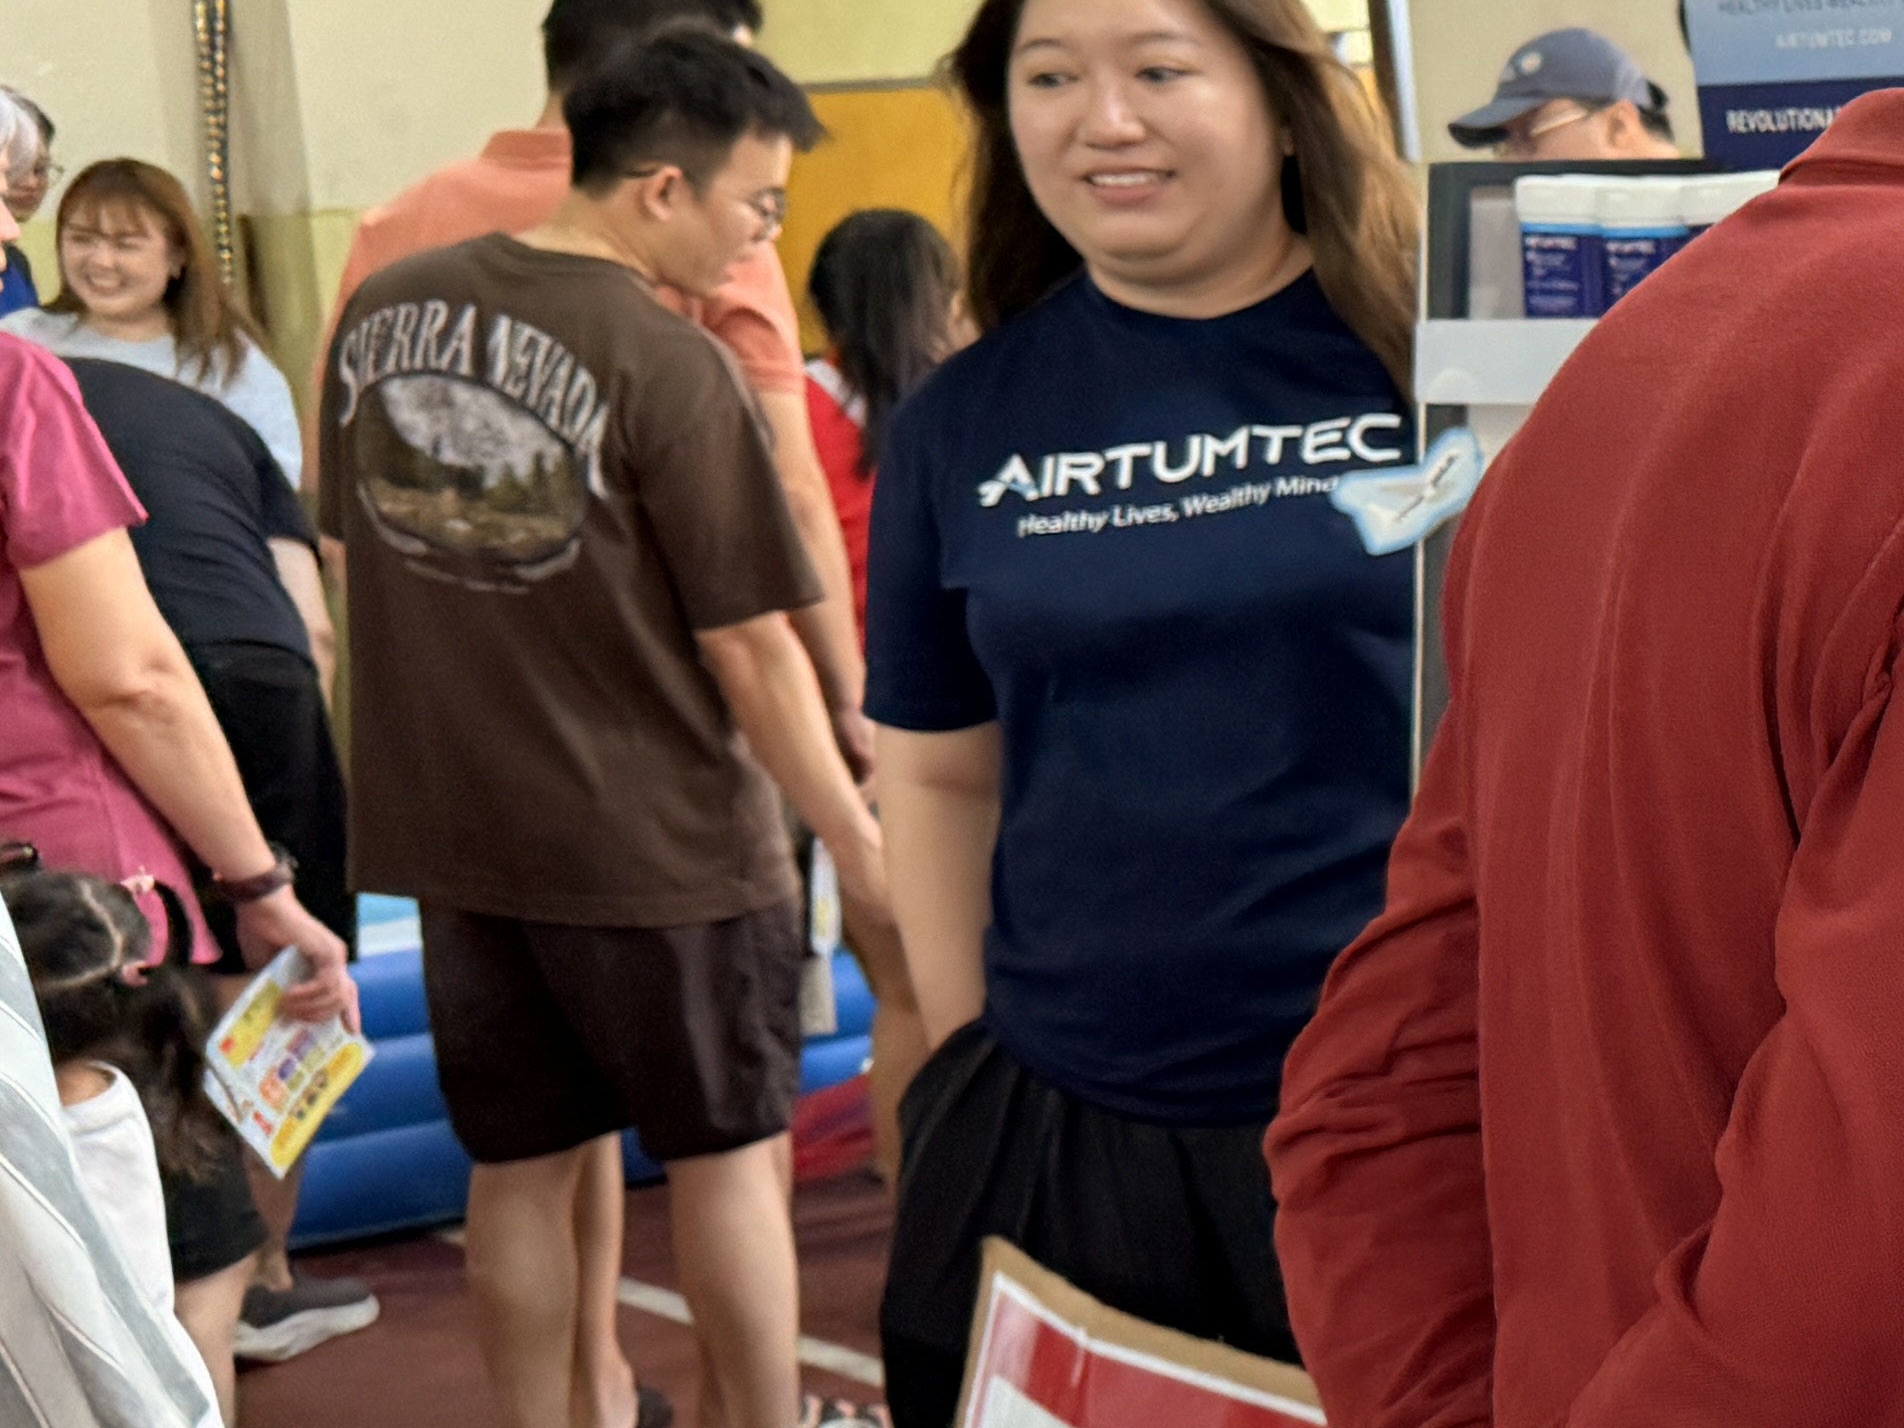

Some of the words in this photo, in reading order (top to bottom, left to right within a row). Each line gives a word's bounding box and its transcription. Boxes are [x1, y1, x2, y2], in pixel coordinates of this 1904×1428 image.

[1726, 106, 1842, 133] REVOLUTION
[339, 299, 477, 427] SIERRA
[487, 314, 609, 500] NEVADA
[977, 413, 1401, 507] AIRTUMTEC
[1017, 508, 1106, 538] Healthy
[1113, 501, 1180, 529] Lives,
[1184, 485, 1271, 518] Wealthy
[1275, 475, 1340, 498] Mind
